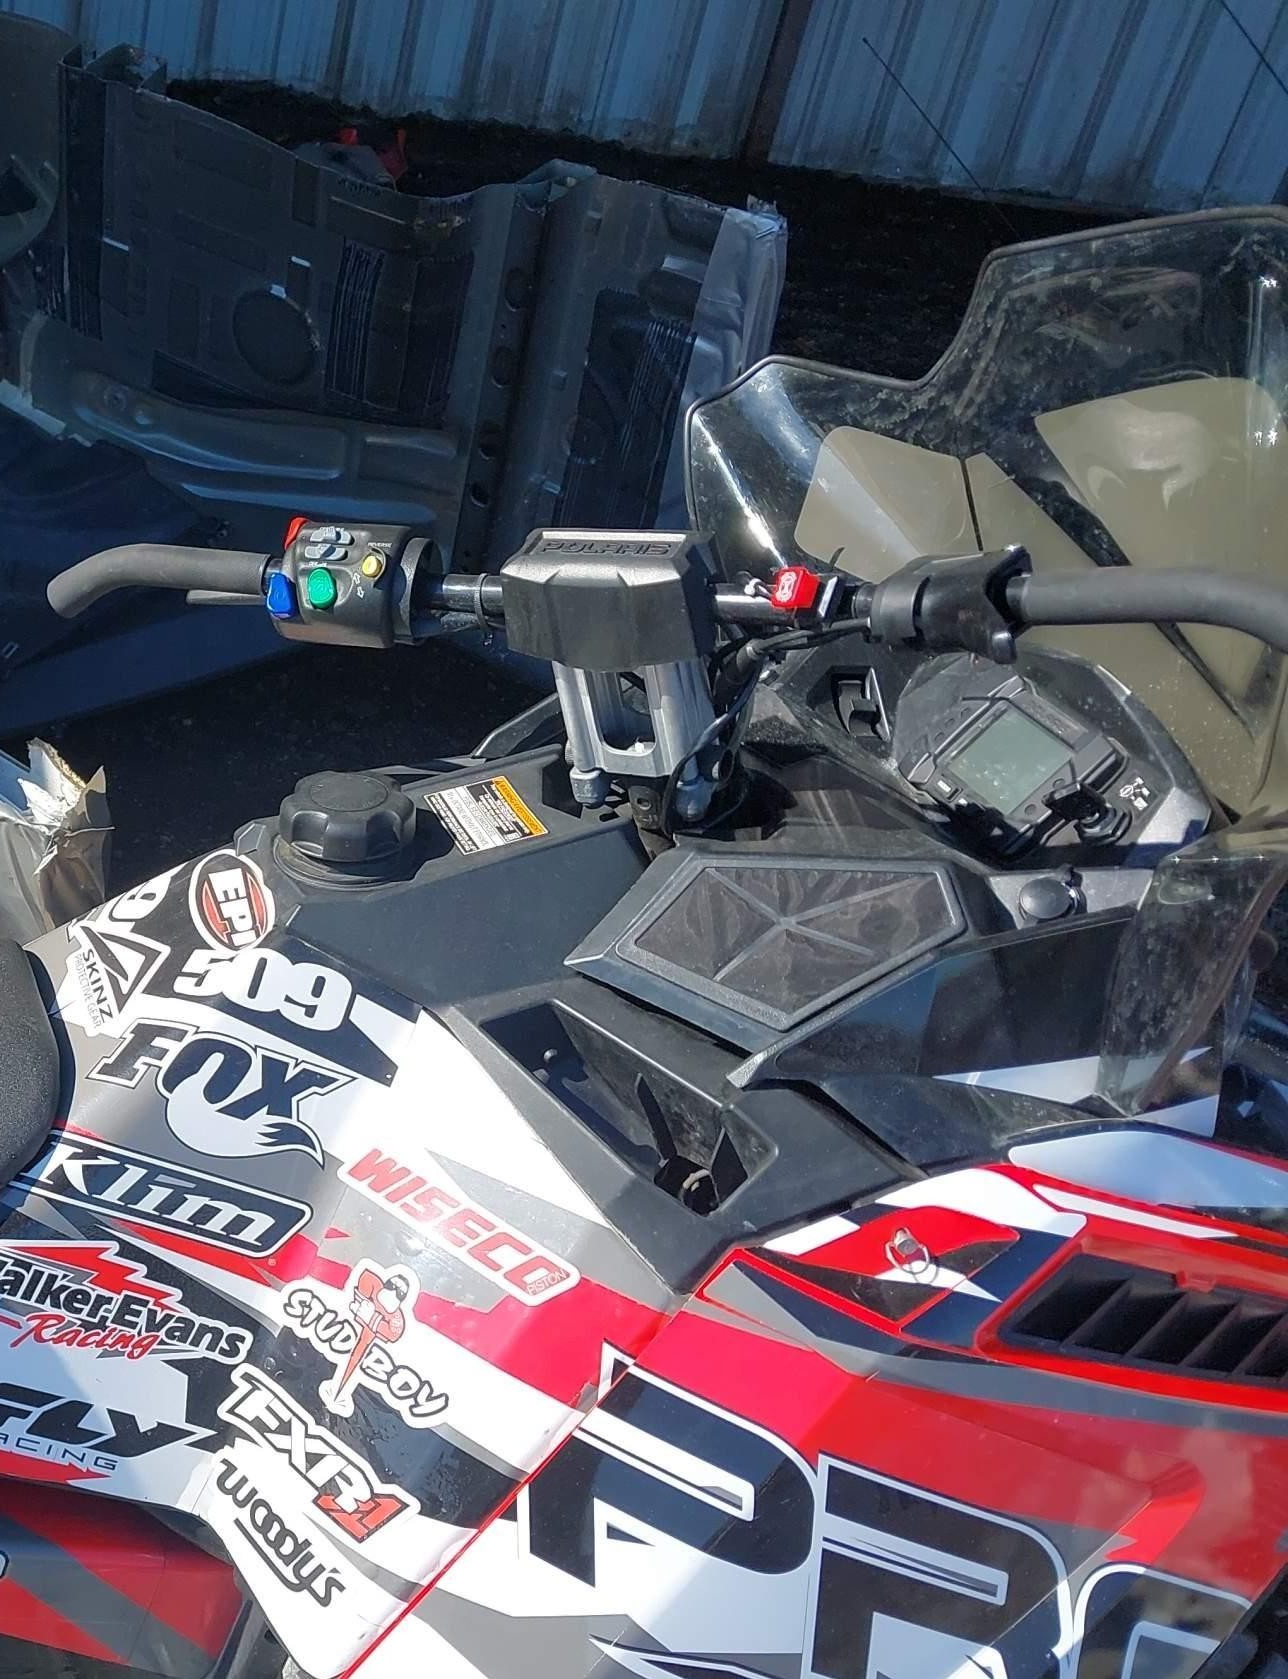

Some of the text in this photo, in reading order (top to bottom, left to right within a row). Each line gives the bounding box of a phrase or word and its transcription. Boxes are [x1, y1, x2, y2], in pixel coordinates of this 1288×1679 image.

[543, 541, 672, 556] POLARIS
[208, 867, 257, 947] EPI
[82, 948, 114, 1020] SKINZ
[173, 947, 352, 1031] 509
[88, 1018, 355, 1128] FOX
[347, 1148, 571, 1296] WISECO
[527, 1268, 568, 1296] PISTON
[9, 1312, 164, 1359] Racing
[283, 1288, 450, 1418] STUD BOY
